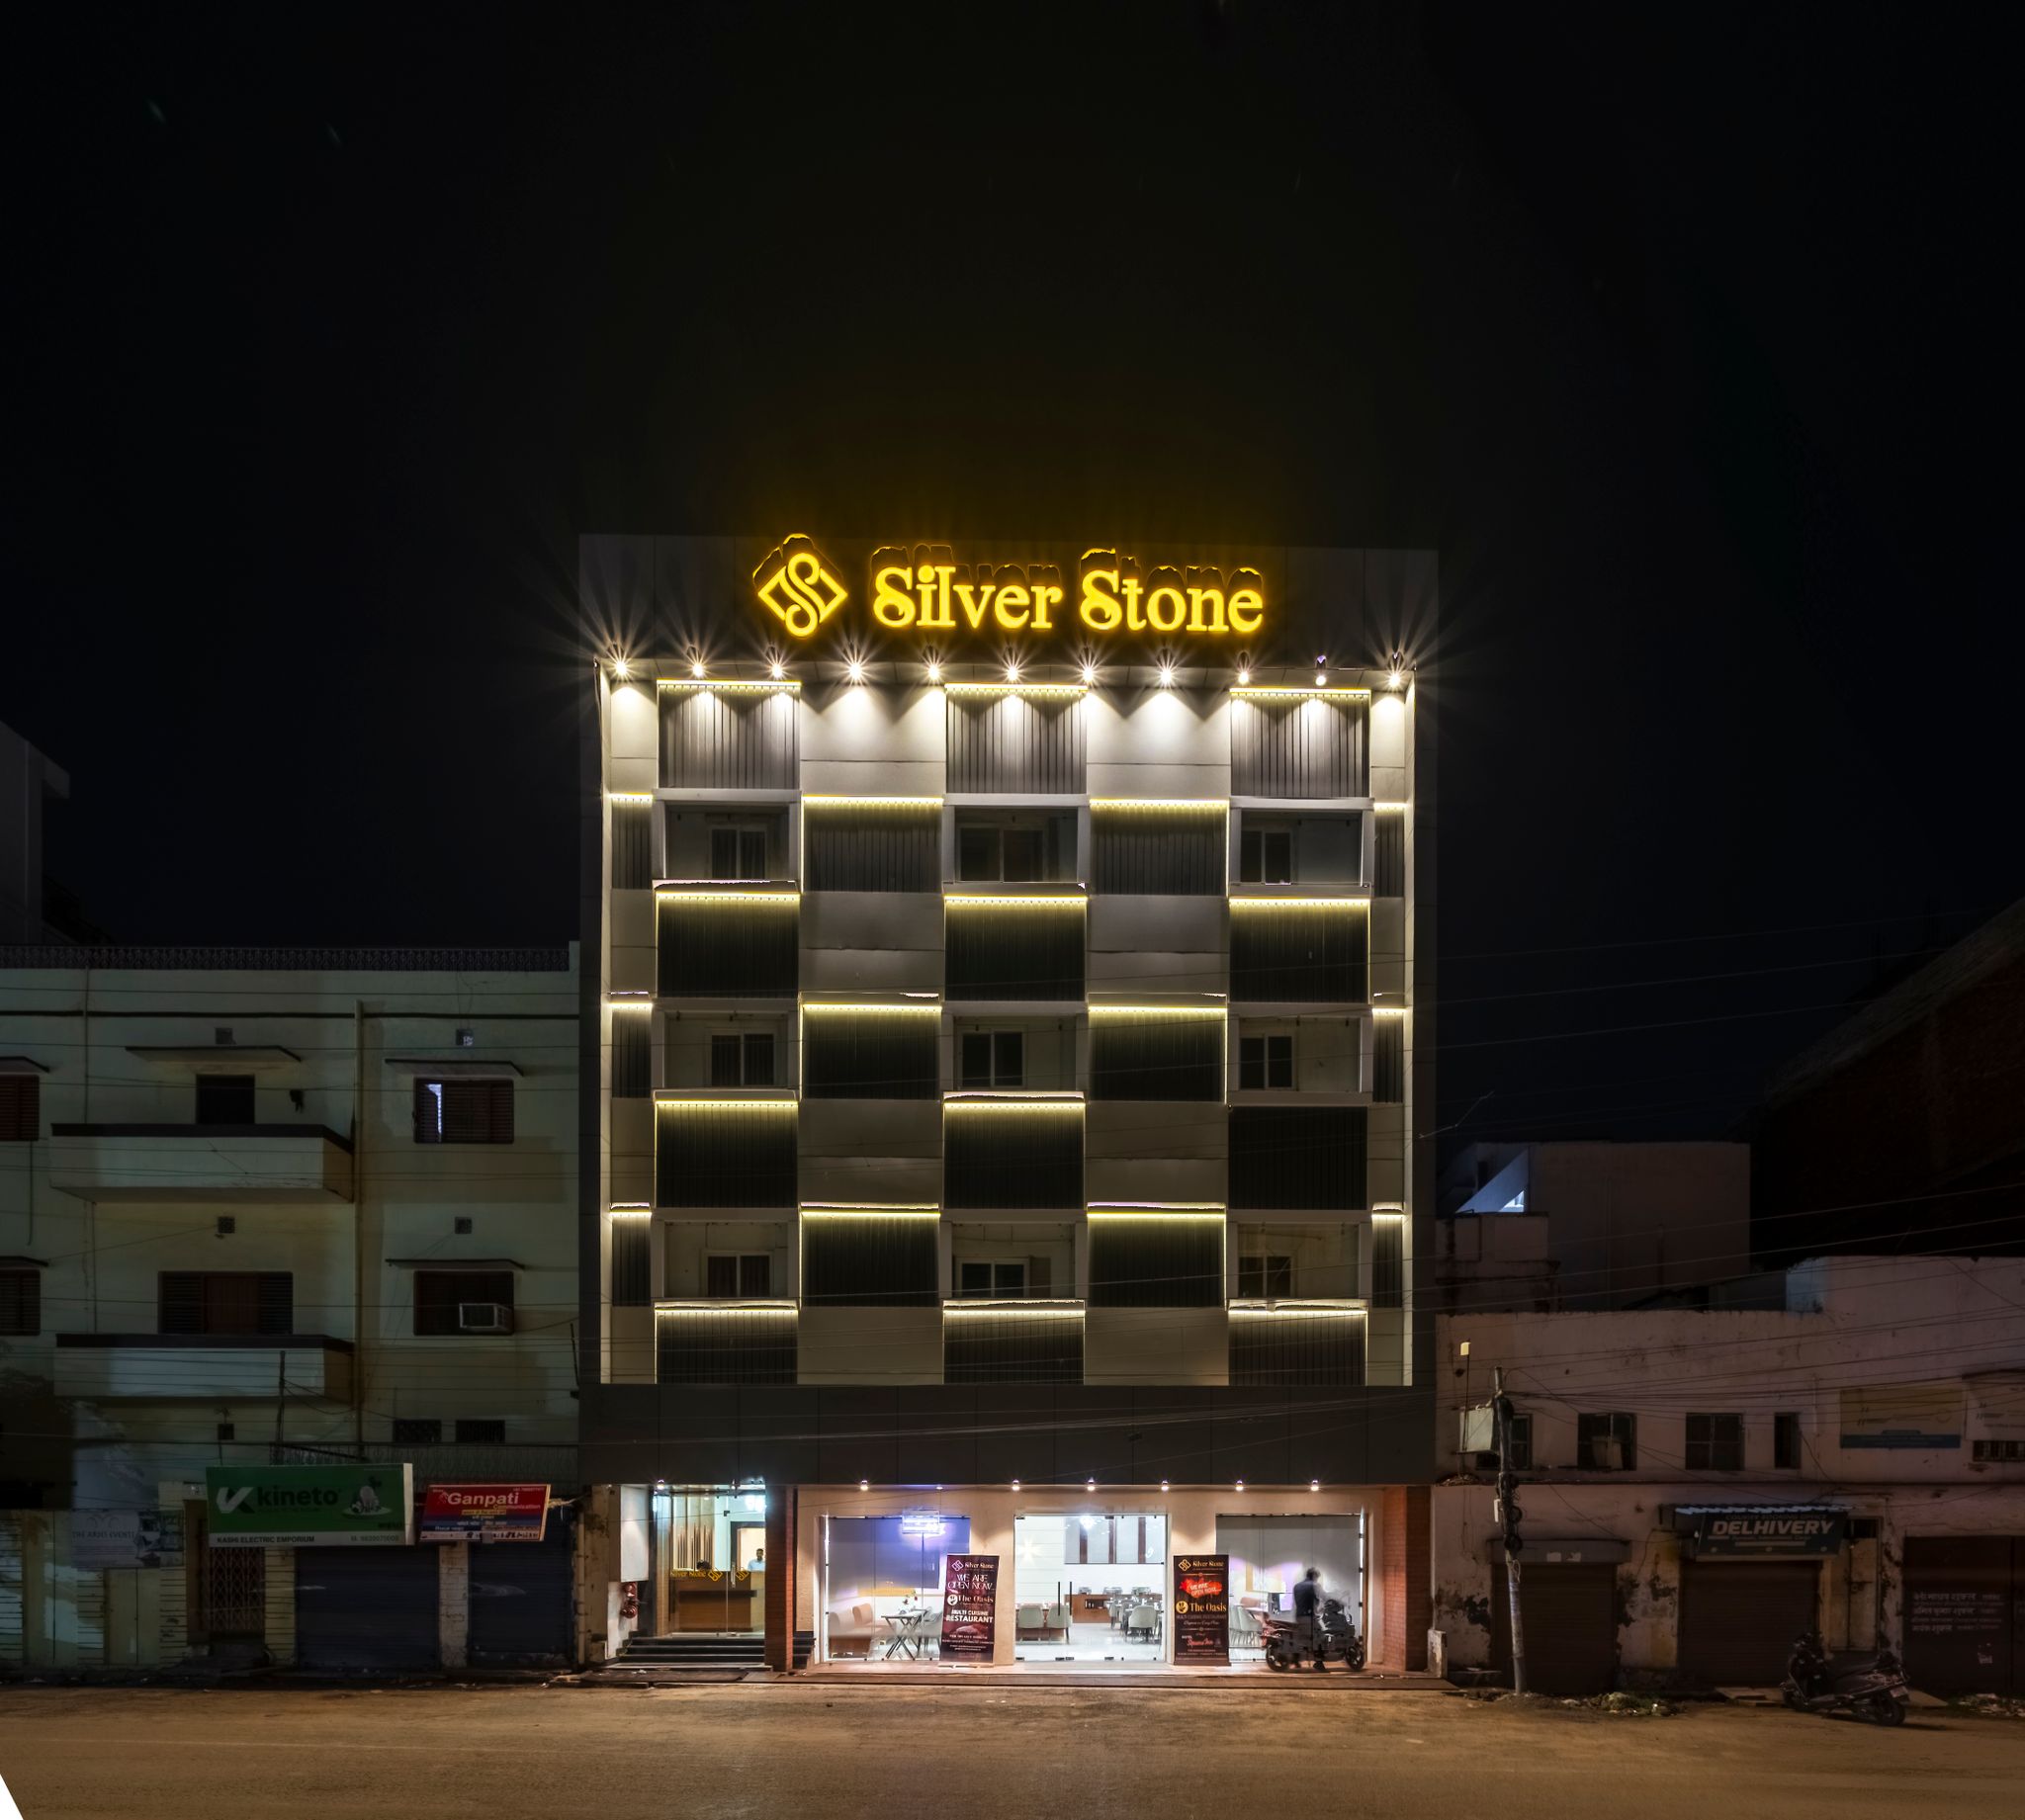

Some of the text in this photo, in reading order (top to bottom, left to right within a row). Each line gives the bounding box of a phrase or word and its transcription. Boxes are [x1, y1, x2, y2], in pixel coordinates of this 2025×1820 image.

[873, 564, 1264, 633] Silver Stone
[257, 1485, 338, 1507] kineto
[447, 1492, 519, 1508] Ganpati
[1712, 1519, 1835, 1535] DELHIVERY
[947, 1581, 969, 1590] OPEN
[973, 1595, 994, 1603] Oasis
[1189, 1603, 1227, 1612] The Oasis
[945, 1614, 994, 1623] RESTAURANT
